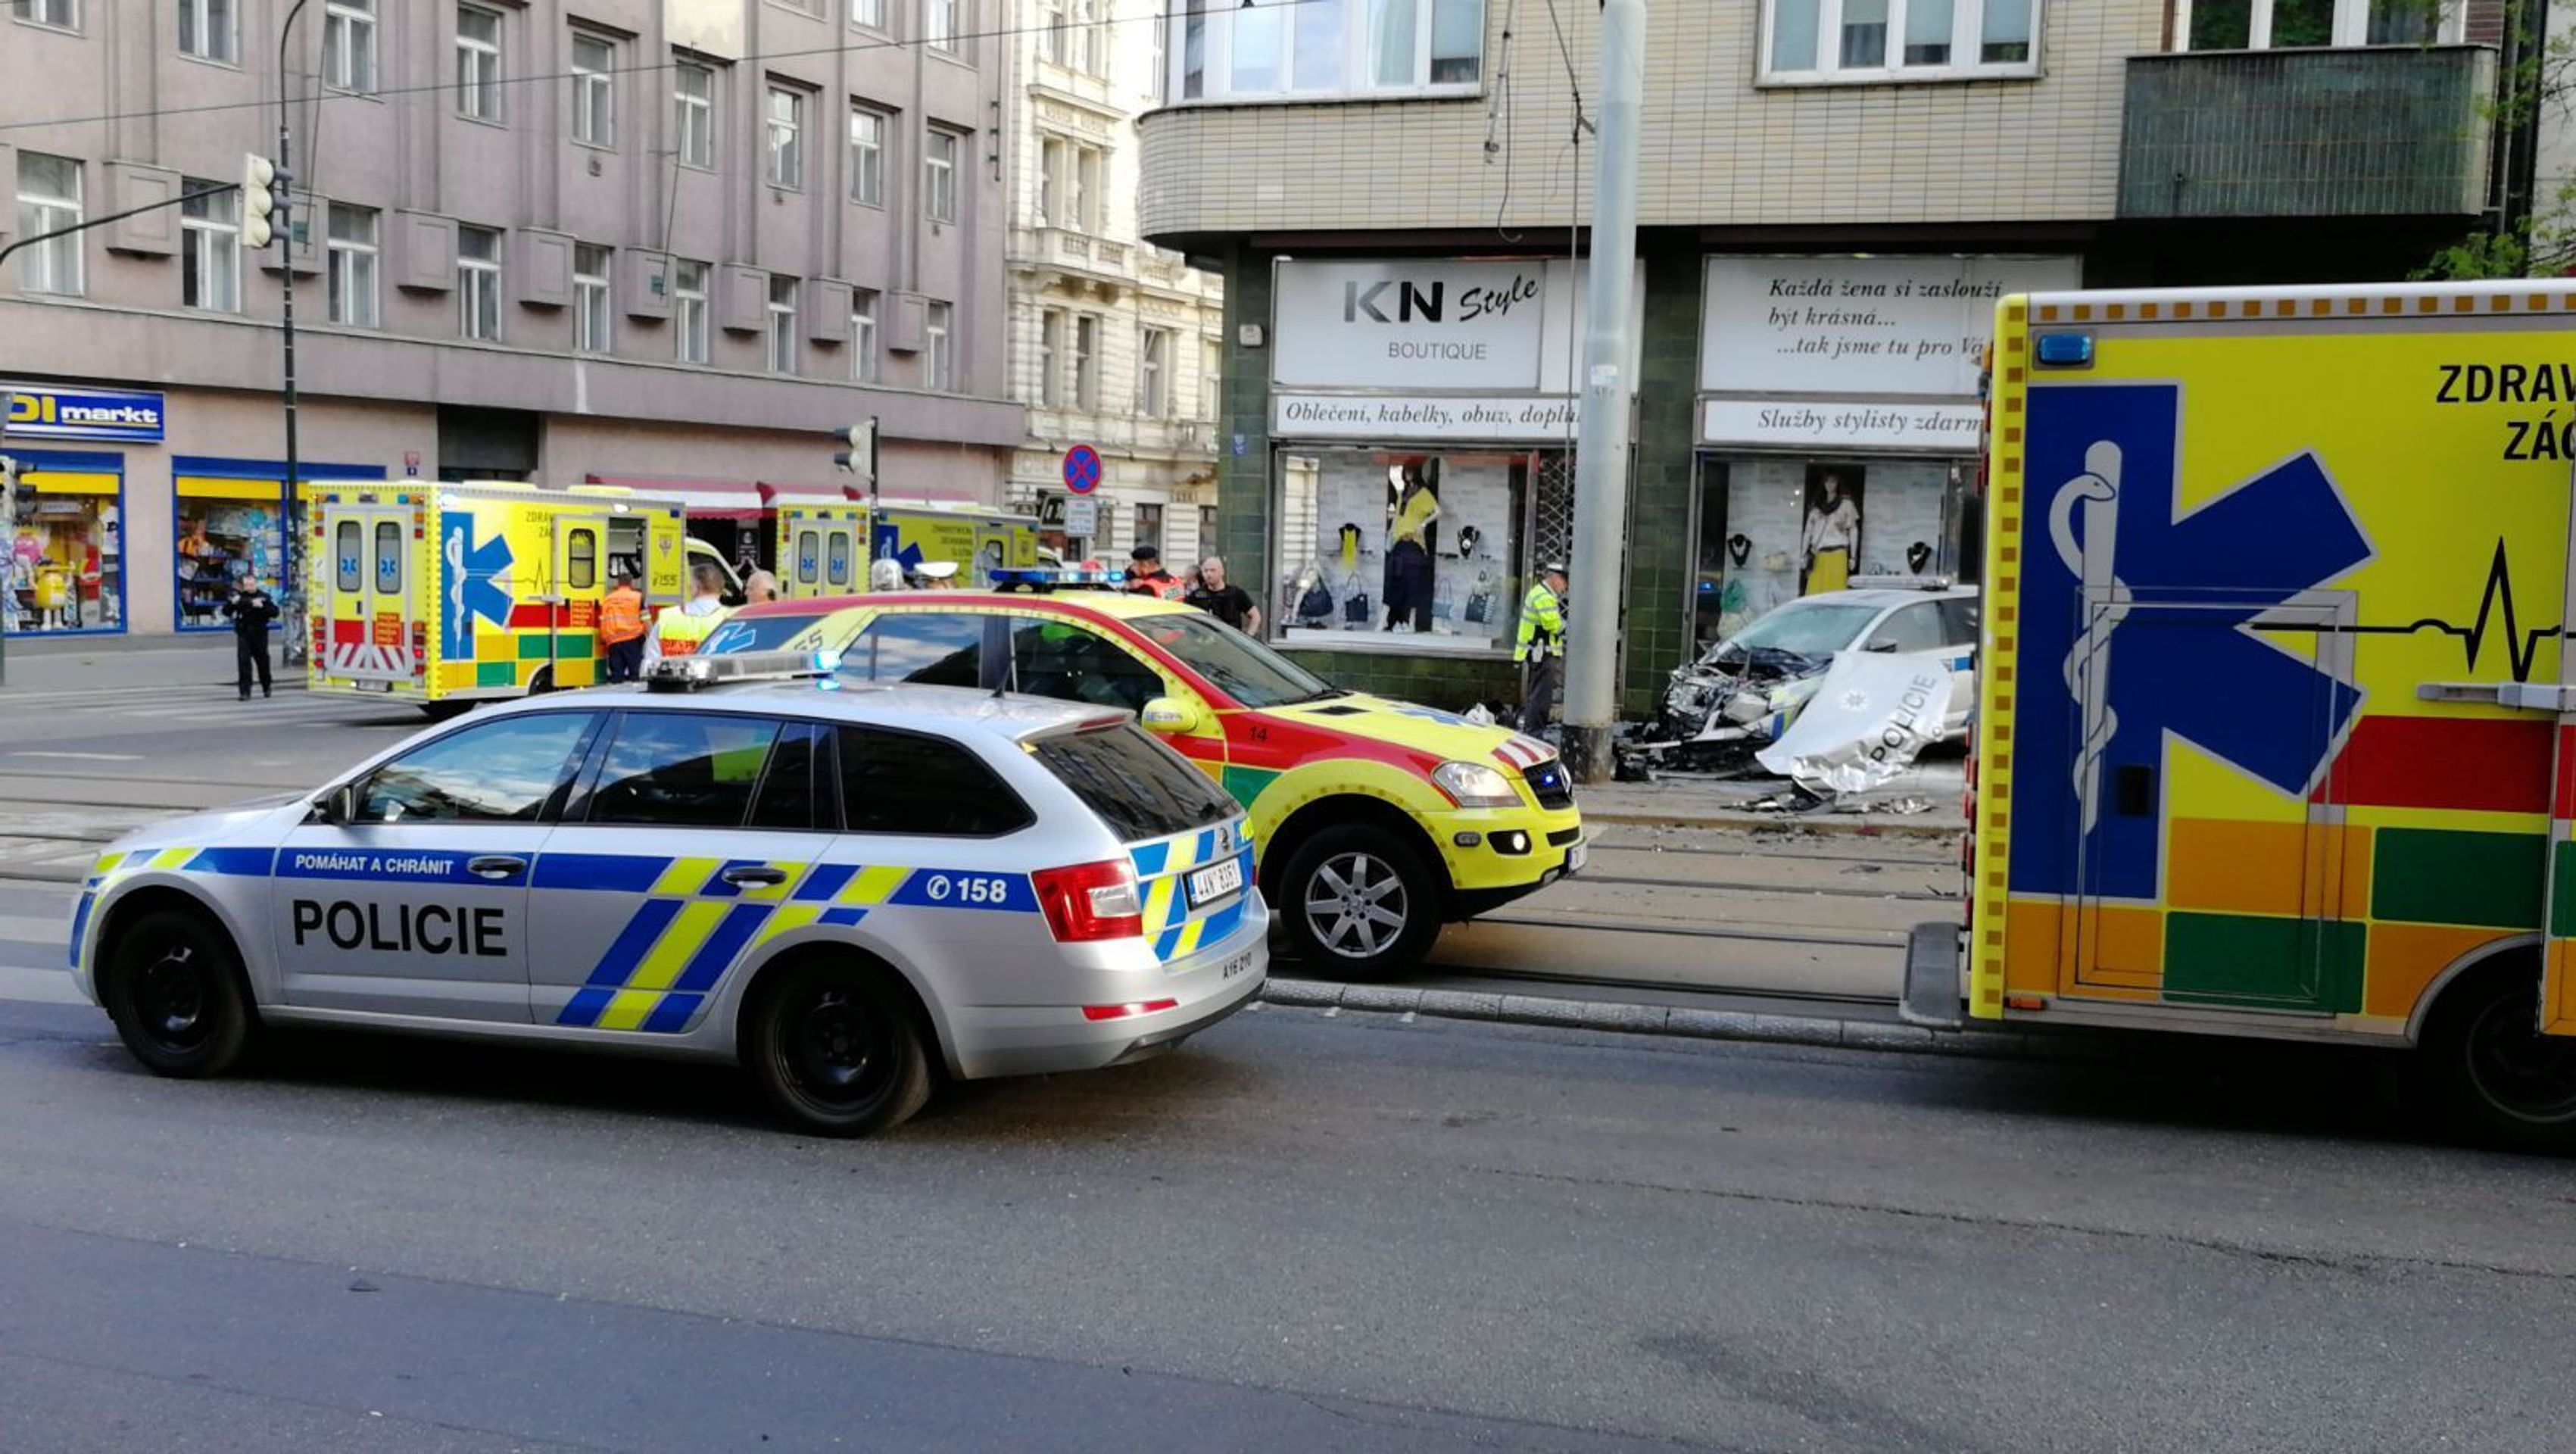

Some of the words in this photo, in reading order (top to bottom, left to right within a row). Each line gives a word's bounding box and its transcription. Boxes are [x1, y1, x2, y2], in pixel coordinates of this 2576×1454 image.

[1345, 282, 1443, 323] KN
[1460, 273, 1539, 322] Style
[1769, 278, 1832, 297] Každá
[1841, 279, 1886, 297] žena
[1893, 279, 1912, 298] si
[1918, 279, 2003, 298] zaslouží
[1769, 306, 1798, 332] být
[1805, 306, 1895, 326] krásná...
[1388, 342, 1487, 360] BOUTIQUE
[1776, 336, 1829, 354] ...tak
[1830, 336, 1881, 360] jsme
[1887, 340, 1909, 354] tu
[1916, 339, 1952, 361] pro
[1960, 336, 1985, 354] Vá
[61, 406, 158, 423] markt
[1286, 402, 1371, 423] Oblečení,
[1377, 404, 1454, 429] kabelky,
[1461, 404, 1513, 424] obuv,
[1757, 409, 1826, 435] Služby
[1832, 409, 1907, 435] stylisty
[1914, 412, 1984, 431] zdarm
[1870, 674, 1937, 763] POLICIE
[1250, 726, 1268, 741] 14
[295, 853, 367, 871] POMÁHAT
[370, 856, 381, 872] A
[385, 856, 454, 875] CHRÁNIT
[956, 878, 1007, 903] 158
[292, 899, 507, 956] POLICIE
